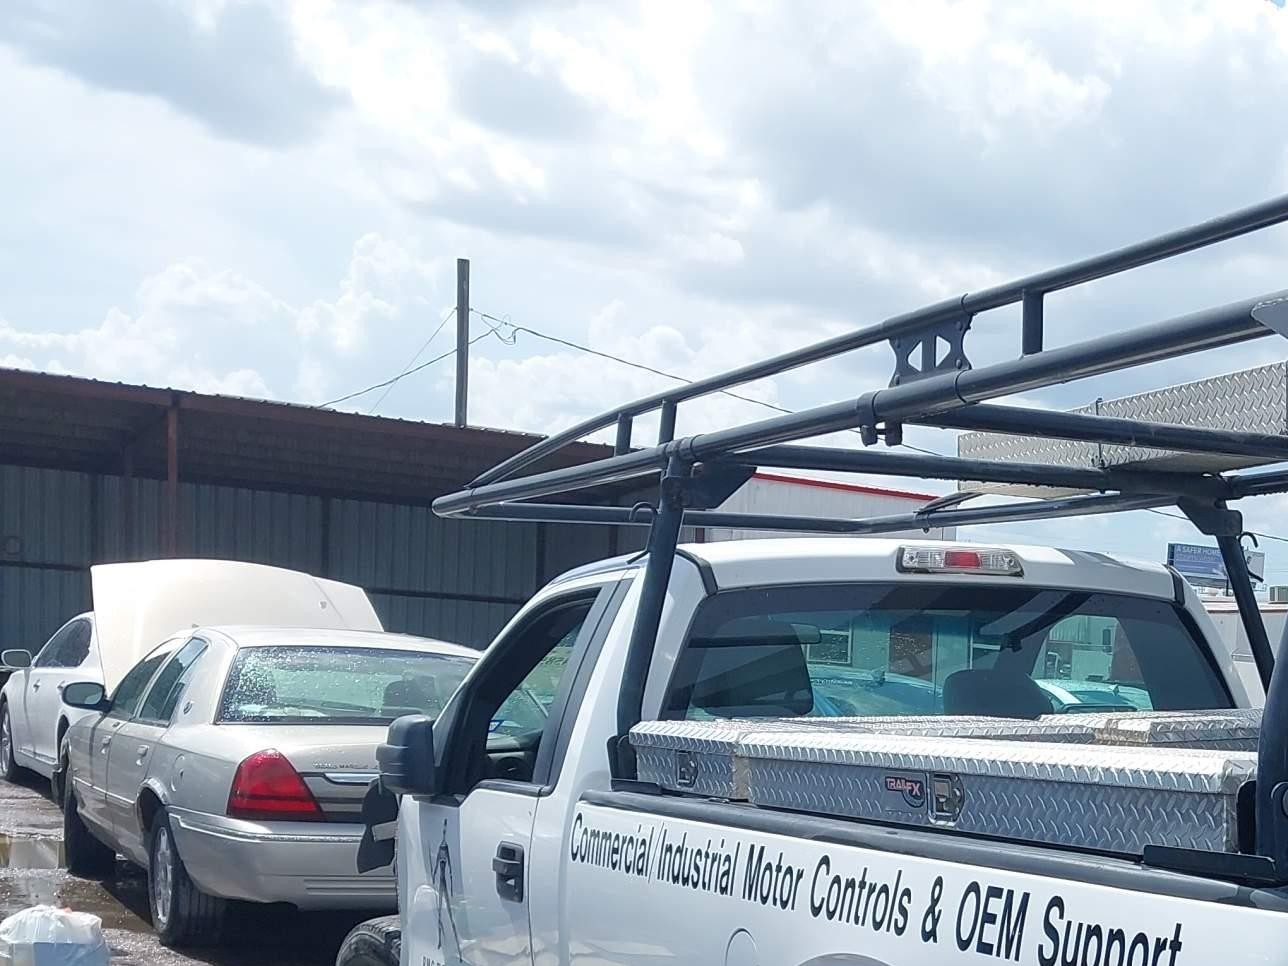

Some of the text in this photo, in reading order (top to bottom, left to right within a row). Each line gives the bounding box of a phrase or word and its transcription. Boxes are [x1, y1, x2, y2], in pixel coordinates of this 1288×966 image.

[742, 844, 805, 911] Motor
[810, 855, 912, 936] Controls
[921, 875, 944, 943] &
[955, 880, 1031, 962] OEM
